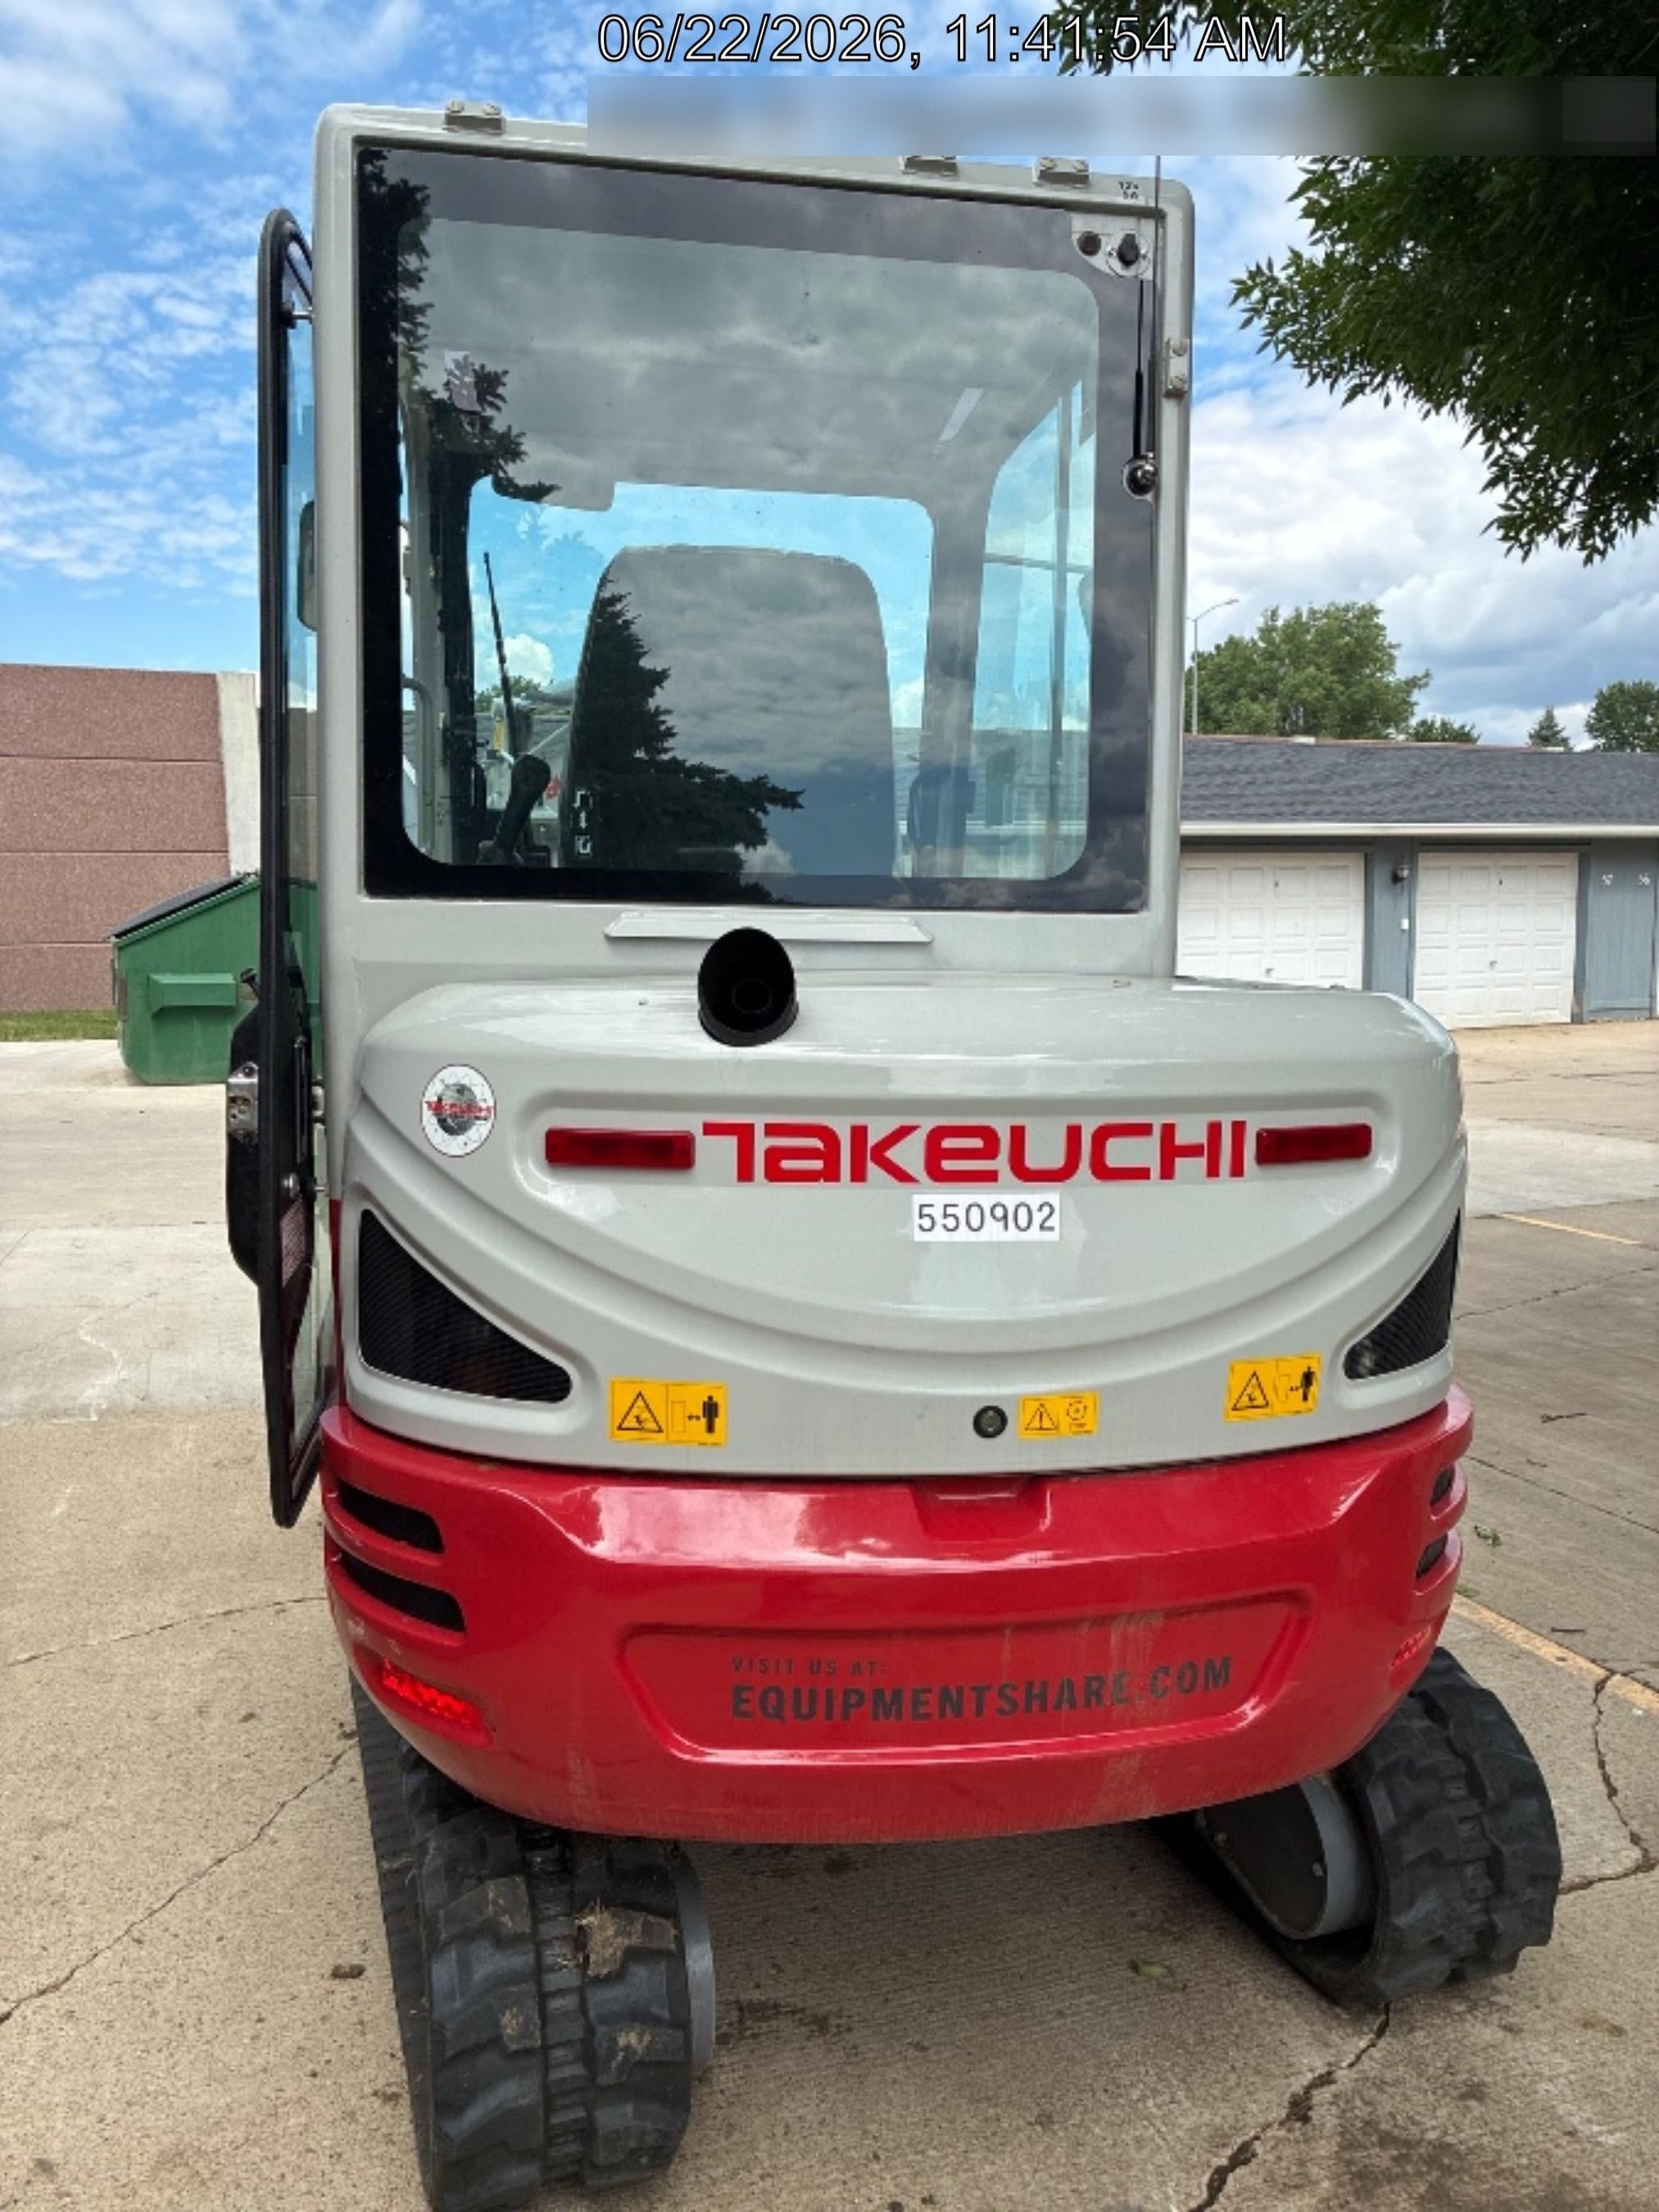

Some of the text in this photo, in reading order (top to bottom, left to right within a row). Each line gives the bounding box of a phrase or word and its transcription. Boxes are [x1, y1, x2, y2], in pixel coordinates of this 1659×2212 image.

[917, 1201, 1056, 1233] 550902
[732, 1657, 886, 1676] VISIT US AT:
[732, 1655, 1232, 1723] EQUIPMENTSHARE.COM
